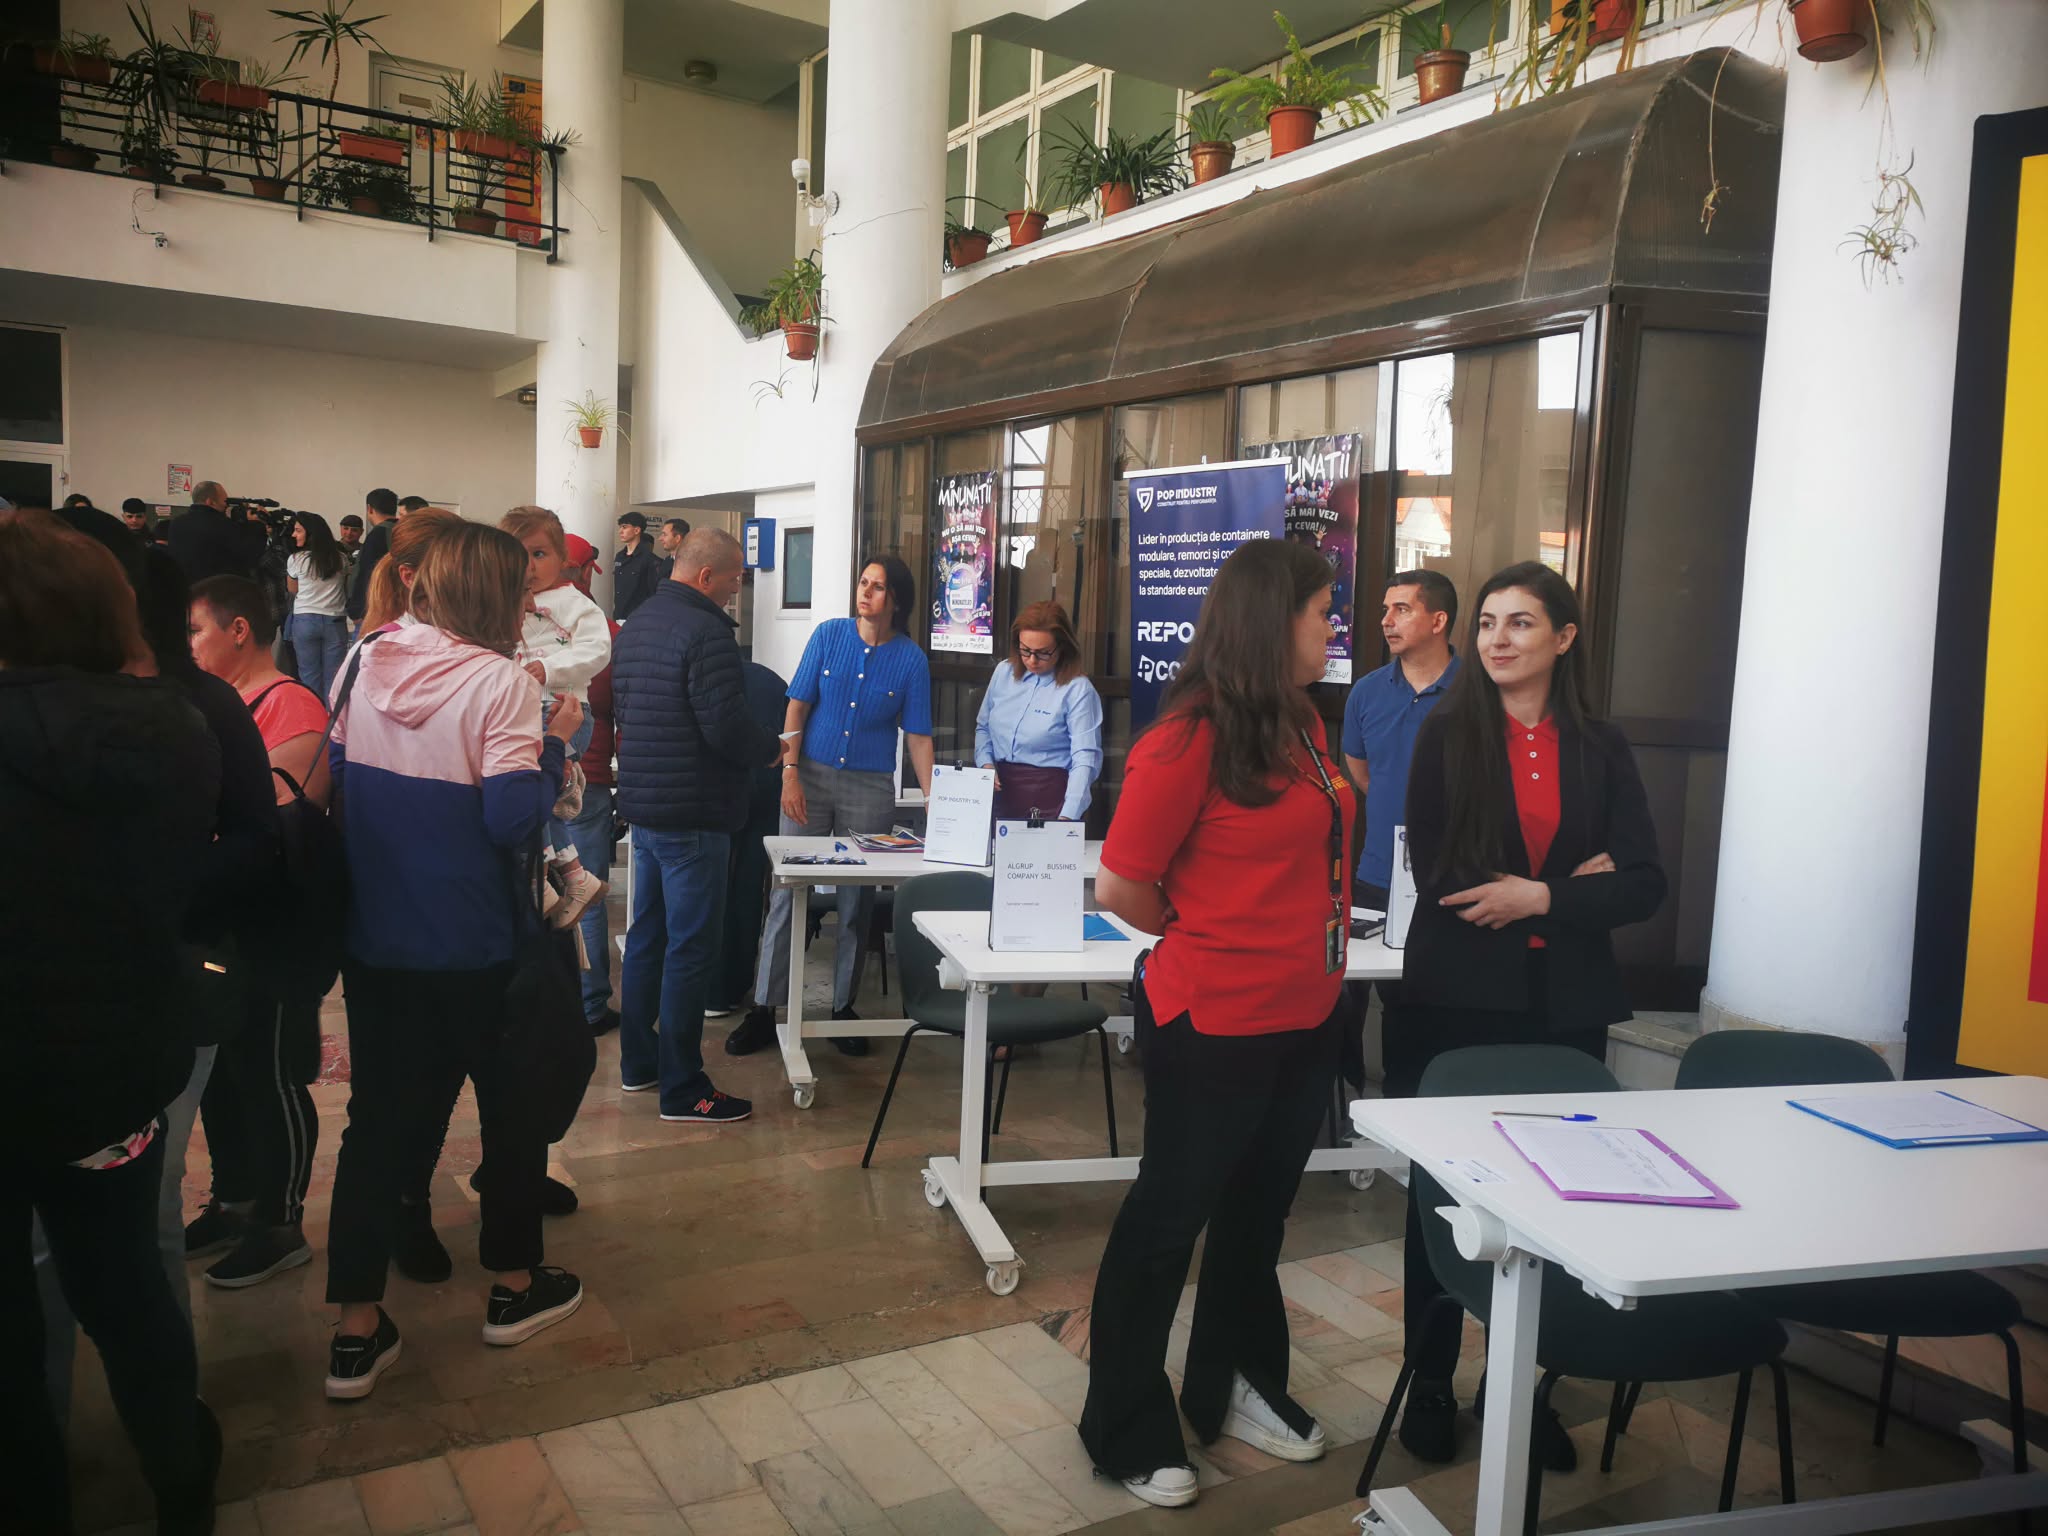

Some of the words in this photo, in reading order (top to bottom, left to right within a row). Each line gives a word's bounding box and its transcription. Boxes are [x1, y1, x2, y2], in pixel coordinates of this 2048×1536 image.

[1157, 489, 1175, 501] POP
[1176, 486, 1217, 499] INDUSTRY
[1300, 508, 1315, 517] MAI
[1319, 509, 1338, 521] VEZI
[1295, 522, 1319, 530] CEVA!
[1139, 534, 1158, 544] Lider
[1160, 533, 1167, 544] în
[1168, 531, 1208, 546] producția
[1209, 531, 1221, 541] de
[1222, 529, 1270, 541] containere
[1139, 550, 1176, 562] modulare,
[1178, 549, 1211, 560] remorci
[1212, 548, 1219, 563] și
[1139, 568, 1171, 581] speciale,
[1140, 585, 1146, 595] la
[1147, 585, 1186, 595] standarde
[1188, 586, 1208, 595] euro
[1137, 621, 1195, 643] REPO
